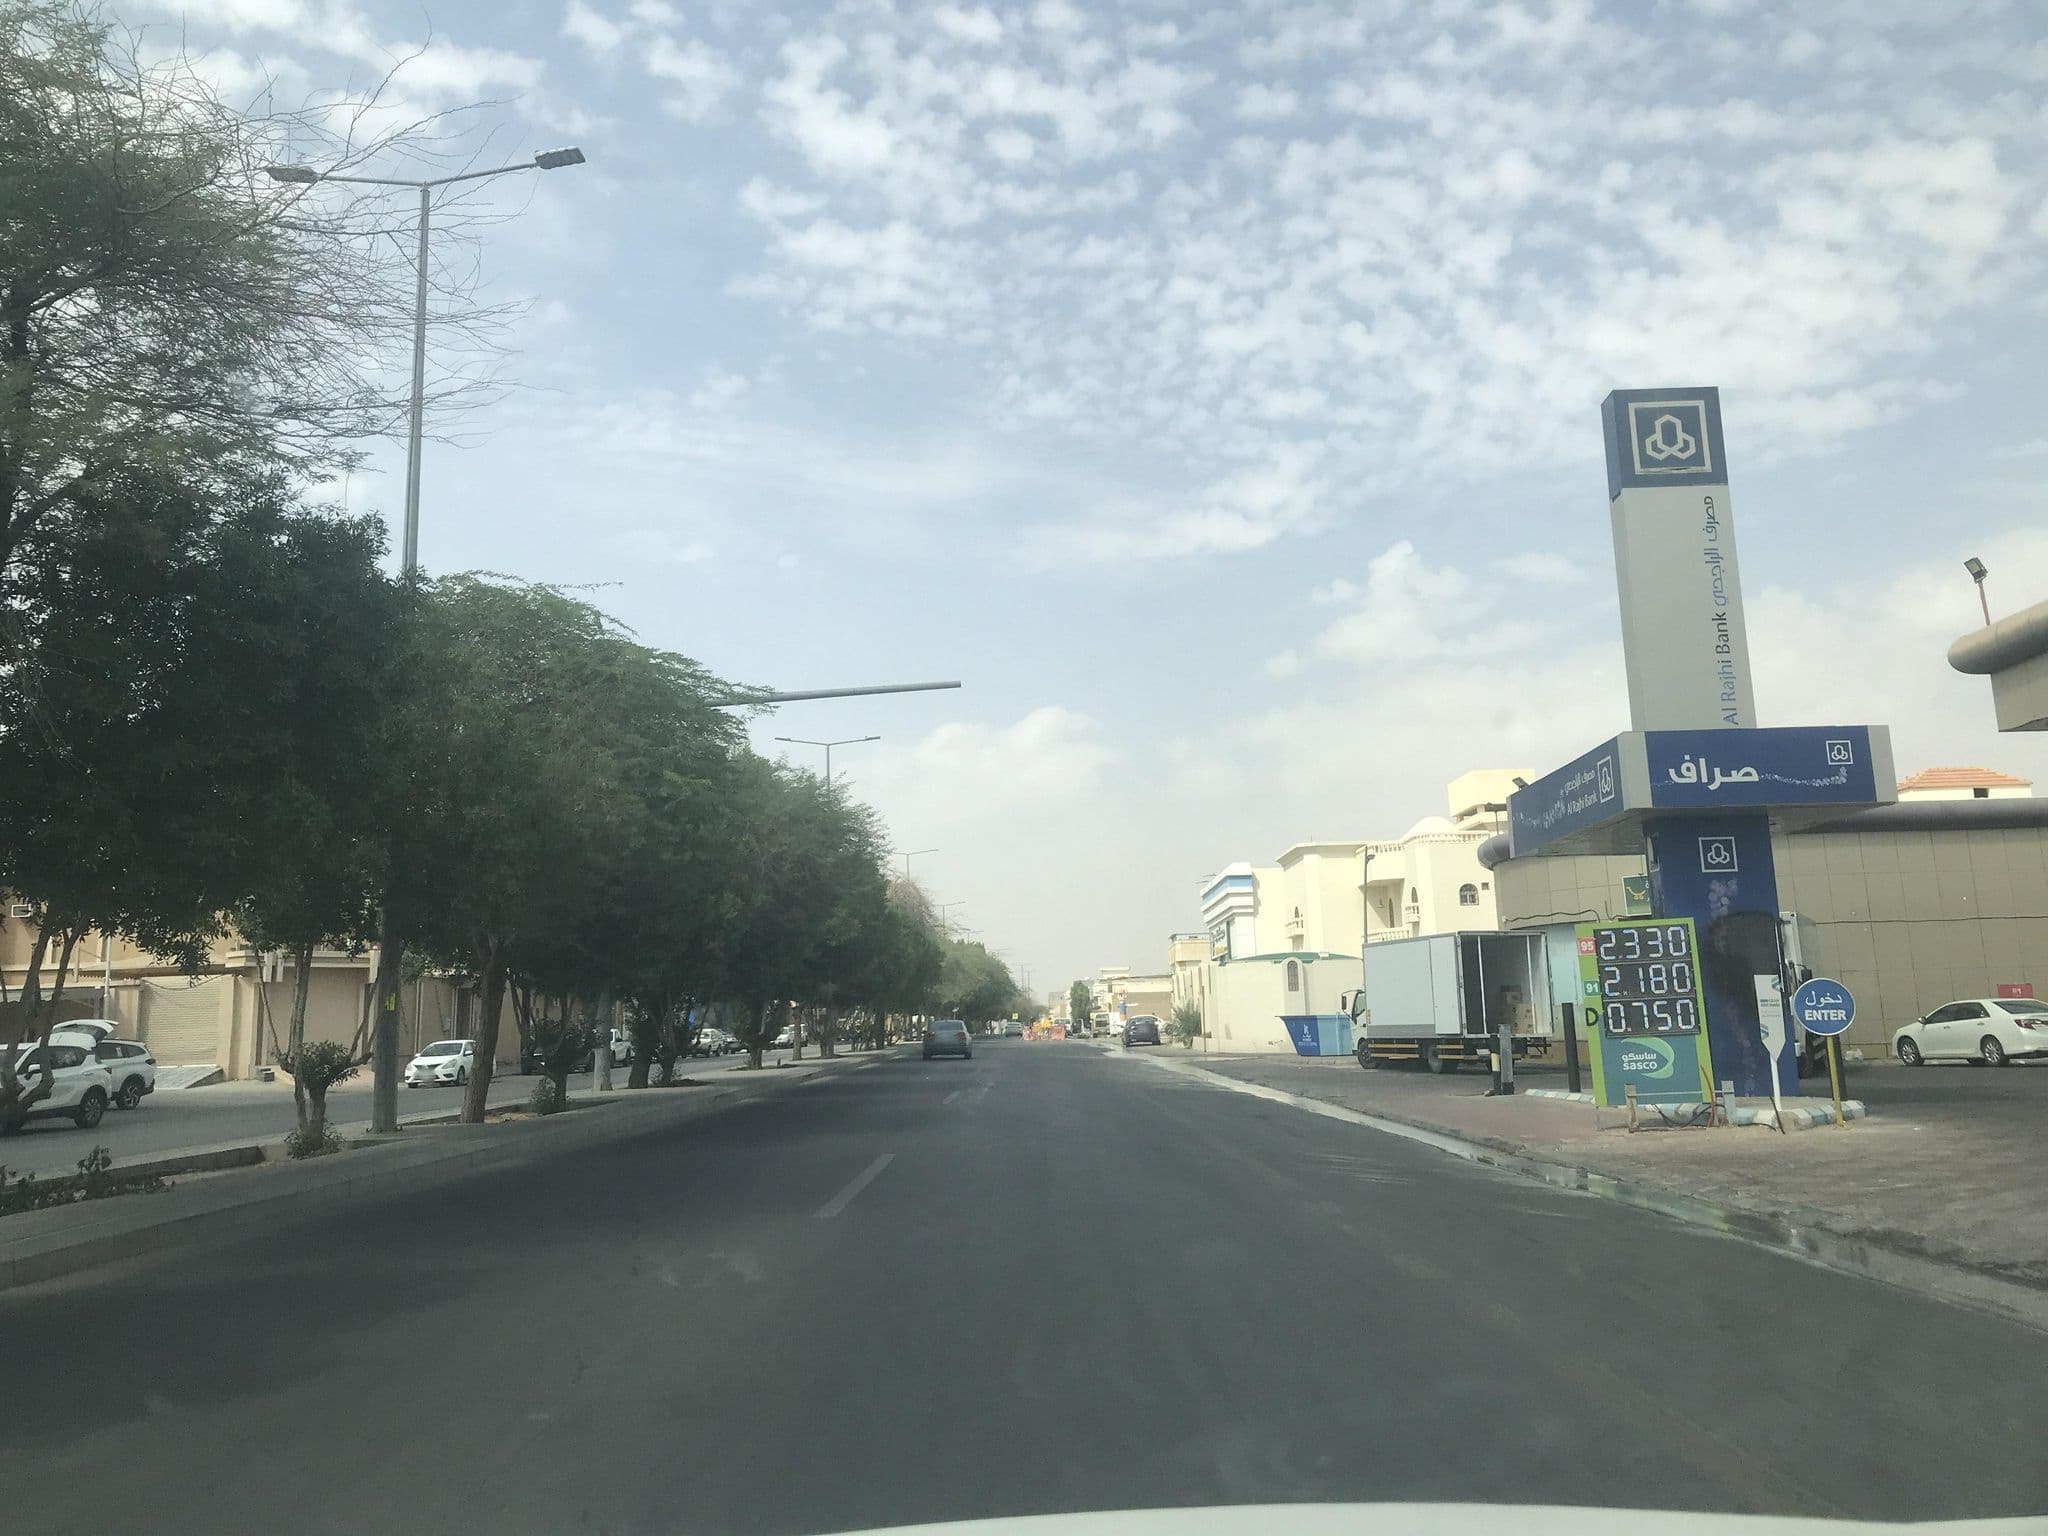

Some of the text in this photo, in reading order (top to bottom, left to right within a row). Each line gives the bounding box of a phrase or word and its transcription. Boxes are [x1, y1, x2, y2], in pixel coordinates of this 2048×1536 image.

[1703, 496, 1728, 607] مصرف الراجحي
[1711, 612, 1739, 725] Al Rajhi Bank
[1668, 754, 1759, 791] صراف
[1580, 941, 1595, 951] 95
[1600, 926, 1688, 960] 2.330
[1585, 983, 1599, 993] 91
[1604, 962, 1692, 997] 2.180
[1805, 991, 1843, 1007] دخول
[1585, 1007, 1599, 1026] D
[1607, 999, 1696, 1033] 0.750
[1804, 1009, 1848, 1021] ENTER
[1621, 1052, 1657, 1063] ساسكو
[1622, 1061, 1658, 1071] sasco
